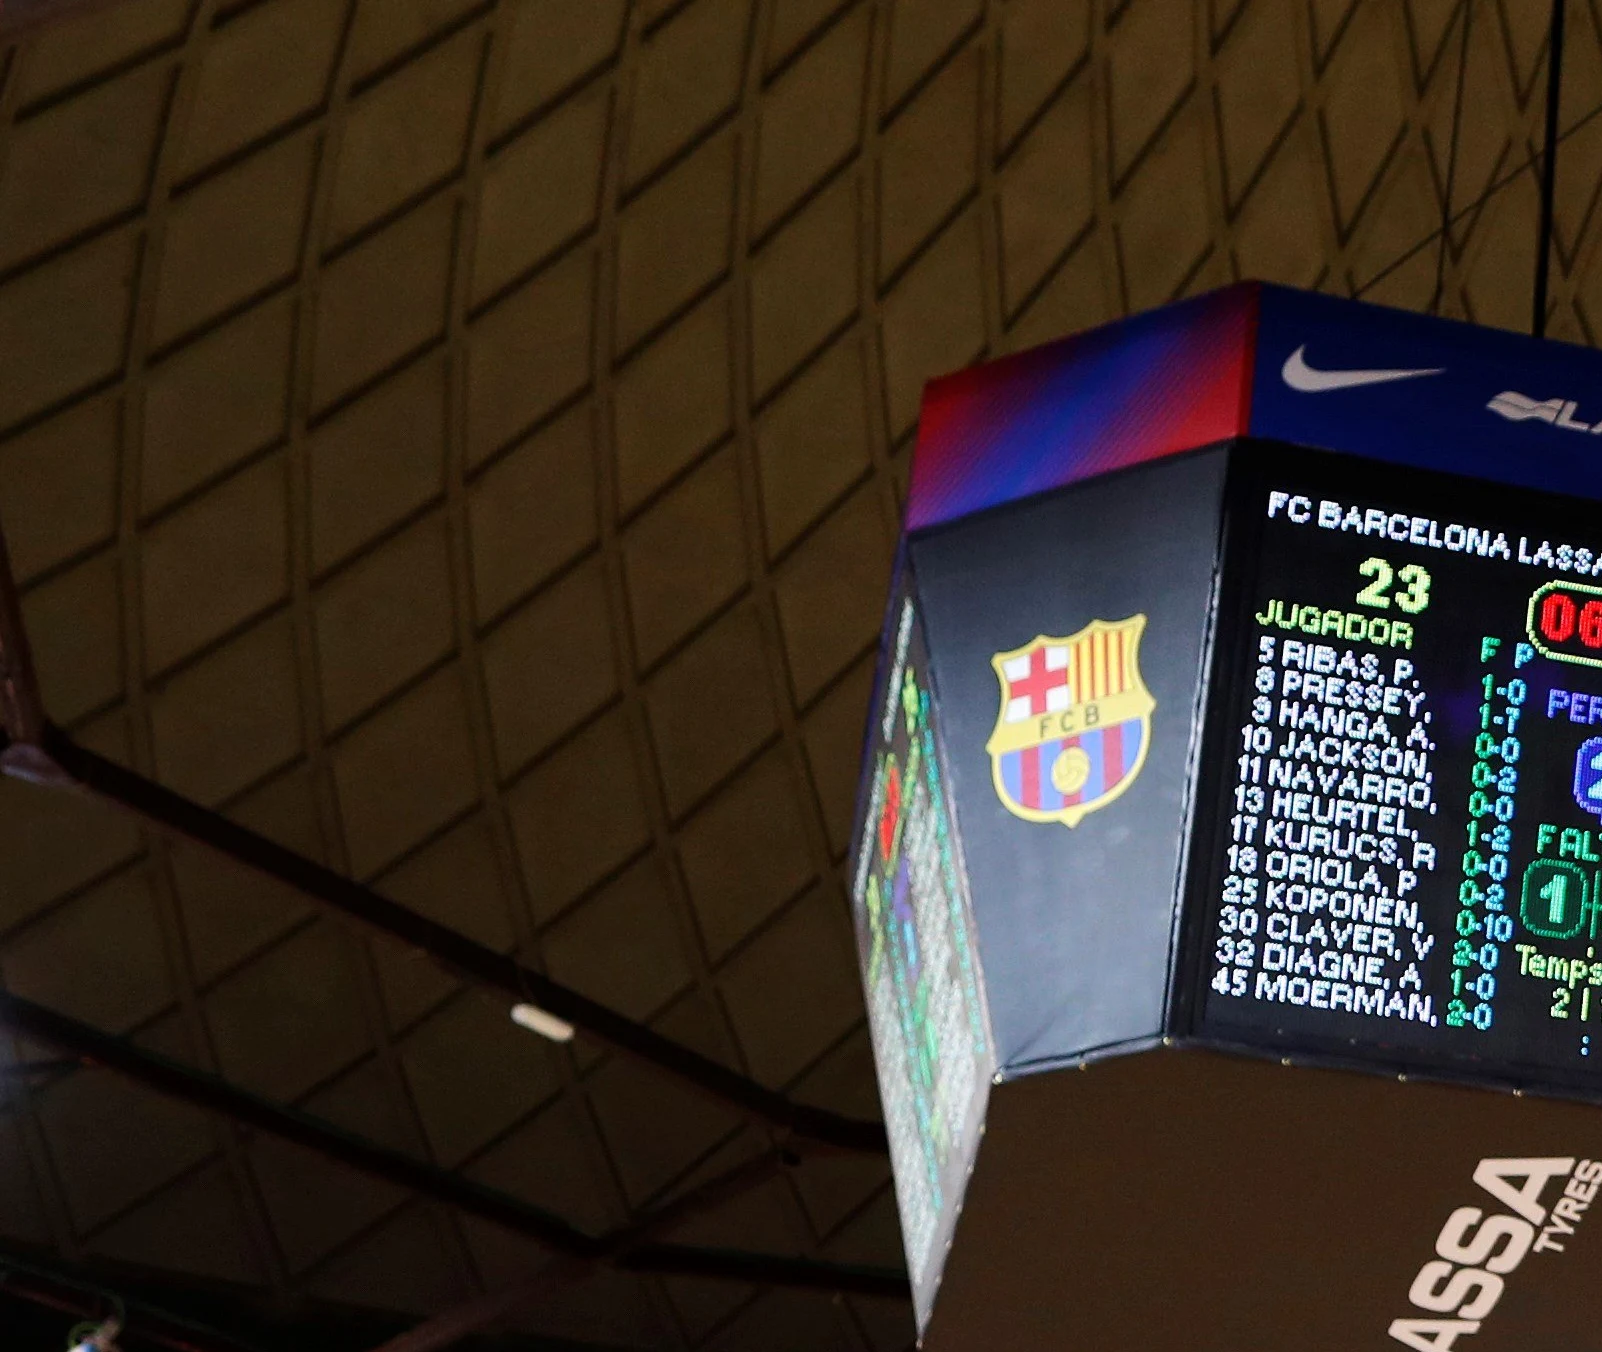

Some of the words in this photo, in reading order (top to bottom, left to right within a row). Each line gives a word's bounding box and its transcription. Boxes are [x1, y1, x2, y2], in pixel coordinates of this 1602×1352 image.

[1267, 491, 1312, 527] FC
[1317, 500, 1510, 562] BARCELONA
[1356, 556, 1431, 615] 23
[1255, 599, 1414, 650] JUGADOR
[1260, 636, 1275, 663] 5
[1282, 642, 1384, 685] RIBAS,
[1394, 659, 1420, 688] P.
[1255, 666, 1275, 693] 8
[1282, 670, 1431, 723] PRESSEY,
[1252, 696, 1272, 723] 9
[1279, 700, 1397, 747] HANGA,
[1407, 722, 1435, 750] A.
[1242, 725, 1272, 754] 10
[1279, 732, 1432, 783] JACKSON,
[1238, 755, 1262, 783] 11
[1269, 759, 1437, 813] NAVARRO,
[1235, 784, 1264, 813] 13
[1273, 790, 1419, 840] HEURTEL,
[1227, 845, 1258, 874] 18
[1266, 850, 1388, 895] ORIOLA,
[1398, 870, 1417, 896] P
[1265, 820, 1403, 869] KURUCS,
[1413, 841, 1436, 869] R
[1222, 875, 1258, 904] 25
[1266, 881, 1424, 932] KOPONEN,
[1541, 874, 1568, 923] 1
[1219, 906, 1258, 935] 30
[1267, 911, 1401, 960] CLAVER,
[1413, 933, 1434, 960] V
[1215, 936, 1255, 966] 32
[1262, 942, 1390, 989] DIAGNE,
[1399, 963, 1421, 990] A
[1212, 966, 1247, 997] 45
[1255, 973, 1437, 1027] MOERMAN,
